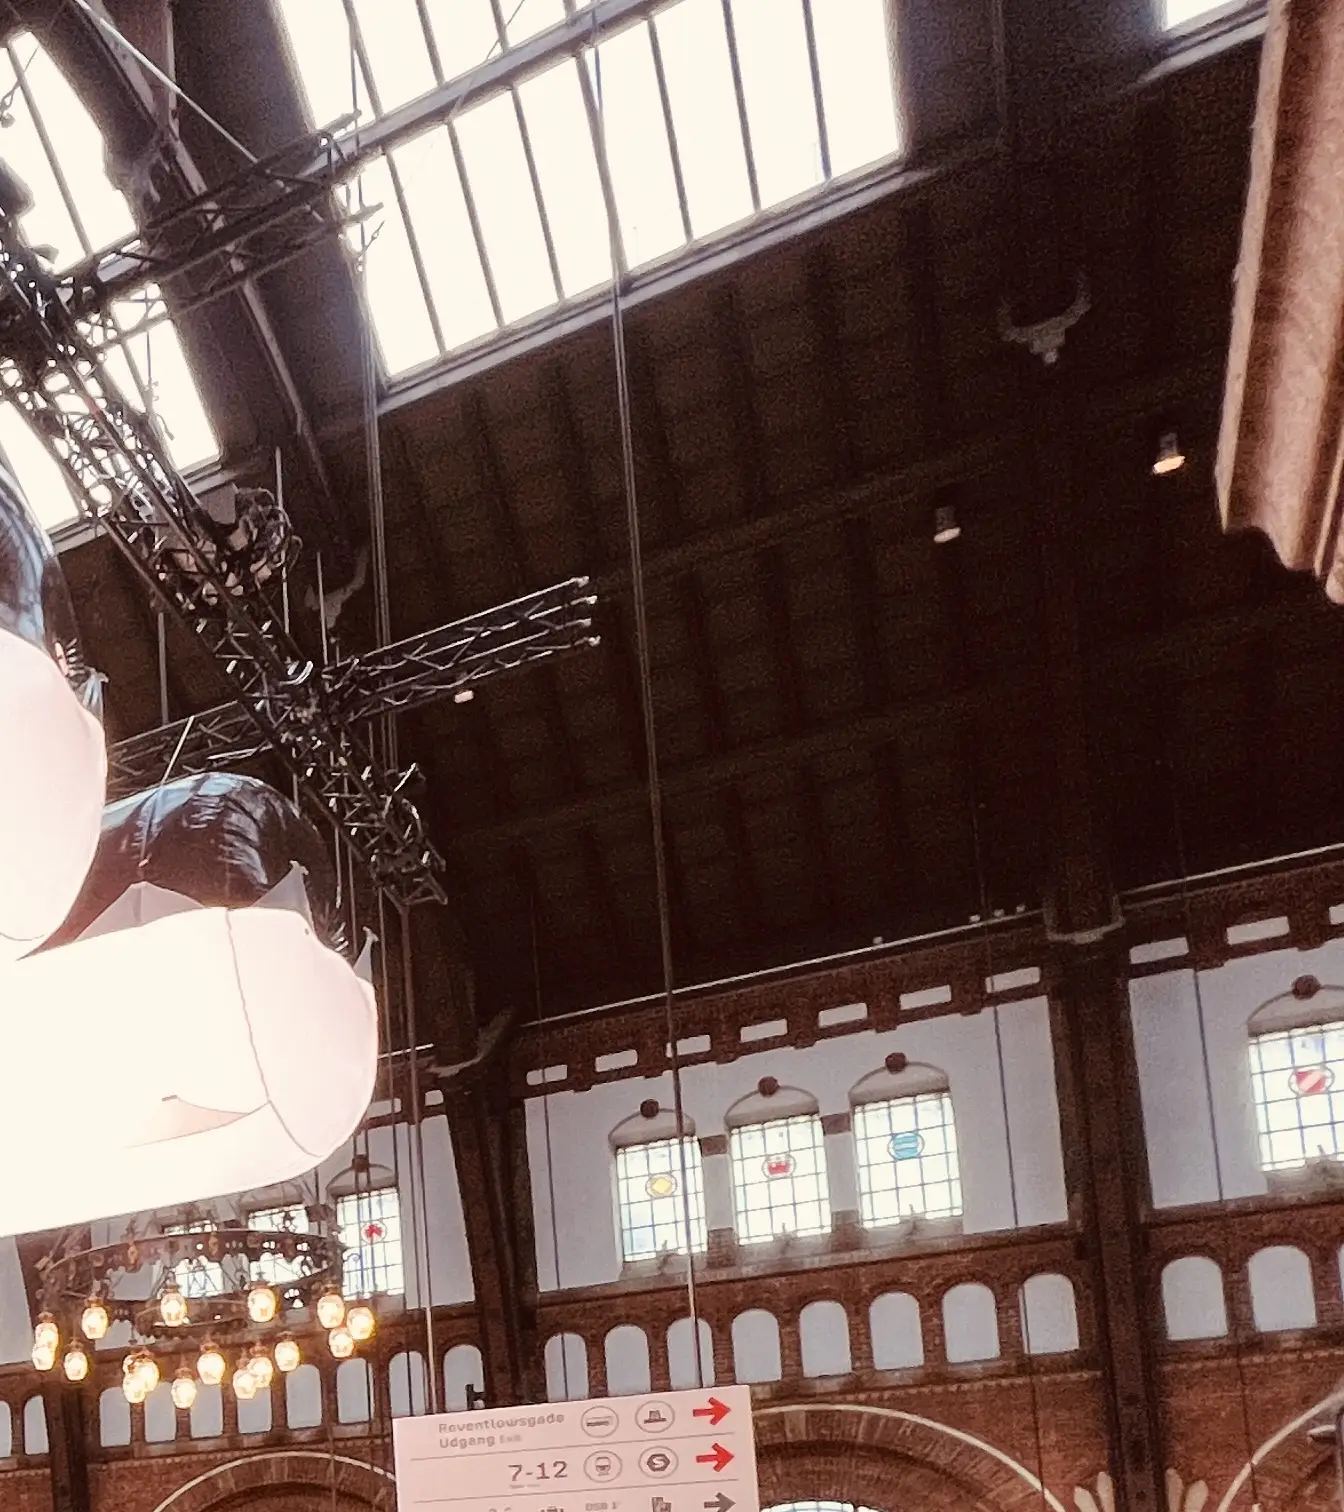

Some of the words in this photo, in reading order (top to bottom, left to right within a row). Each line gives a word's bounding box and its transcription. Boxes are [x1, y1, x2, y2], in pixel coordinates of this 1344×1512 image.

[438, 1413, 565, 1434] Reventlowsgade
[439, 1435, 496, 1449] Udgang
[508, 1460, 568, 1482] 7-12
